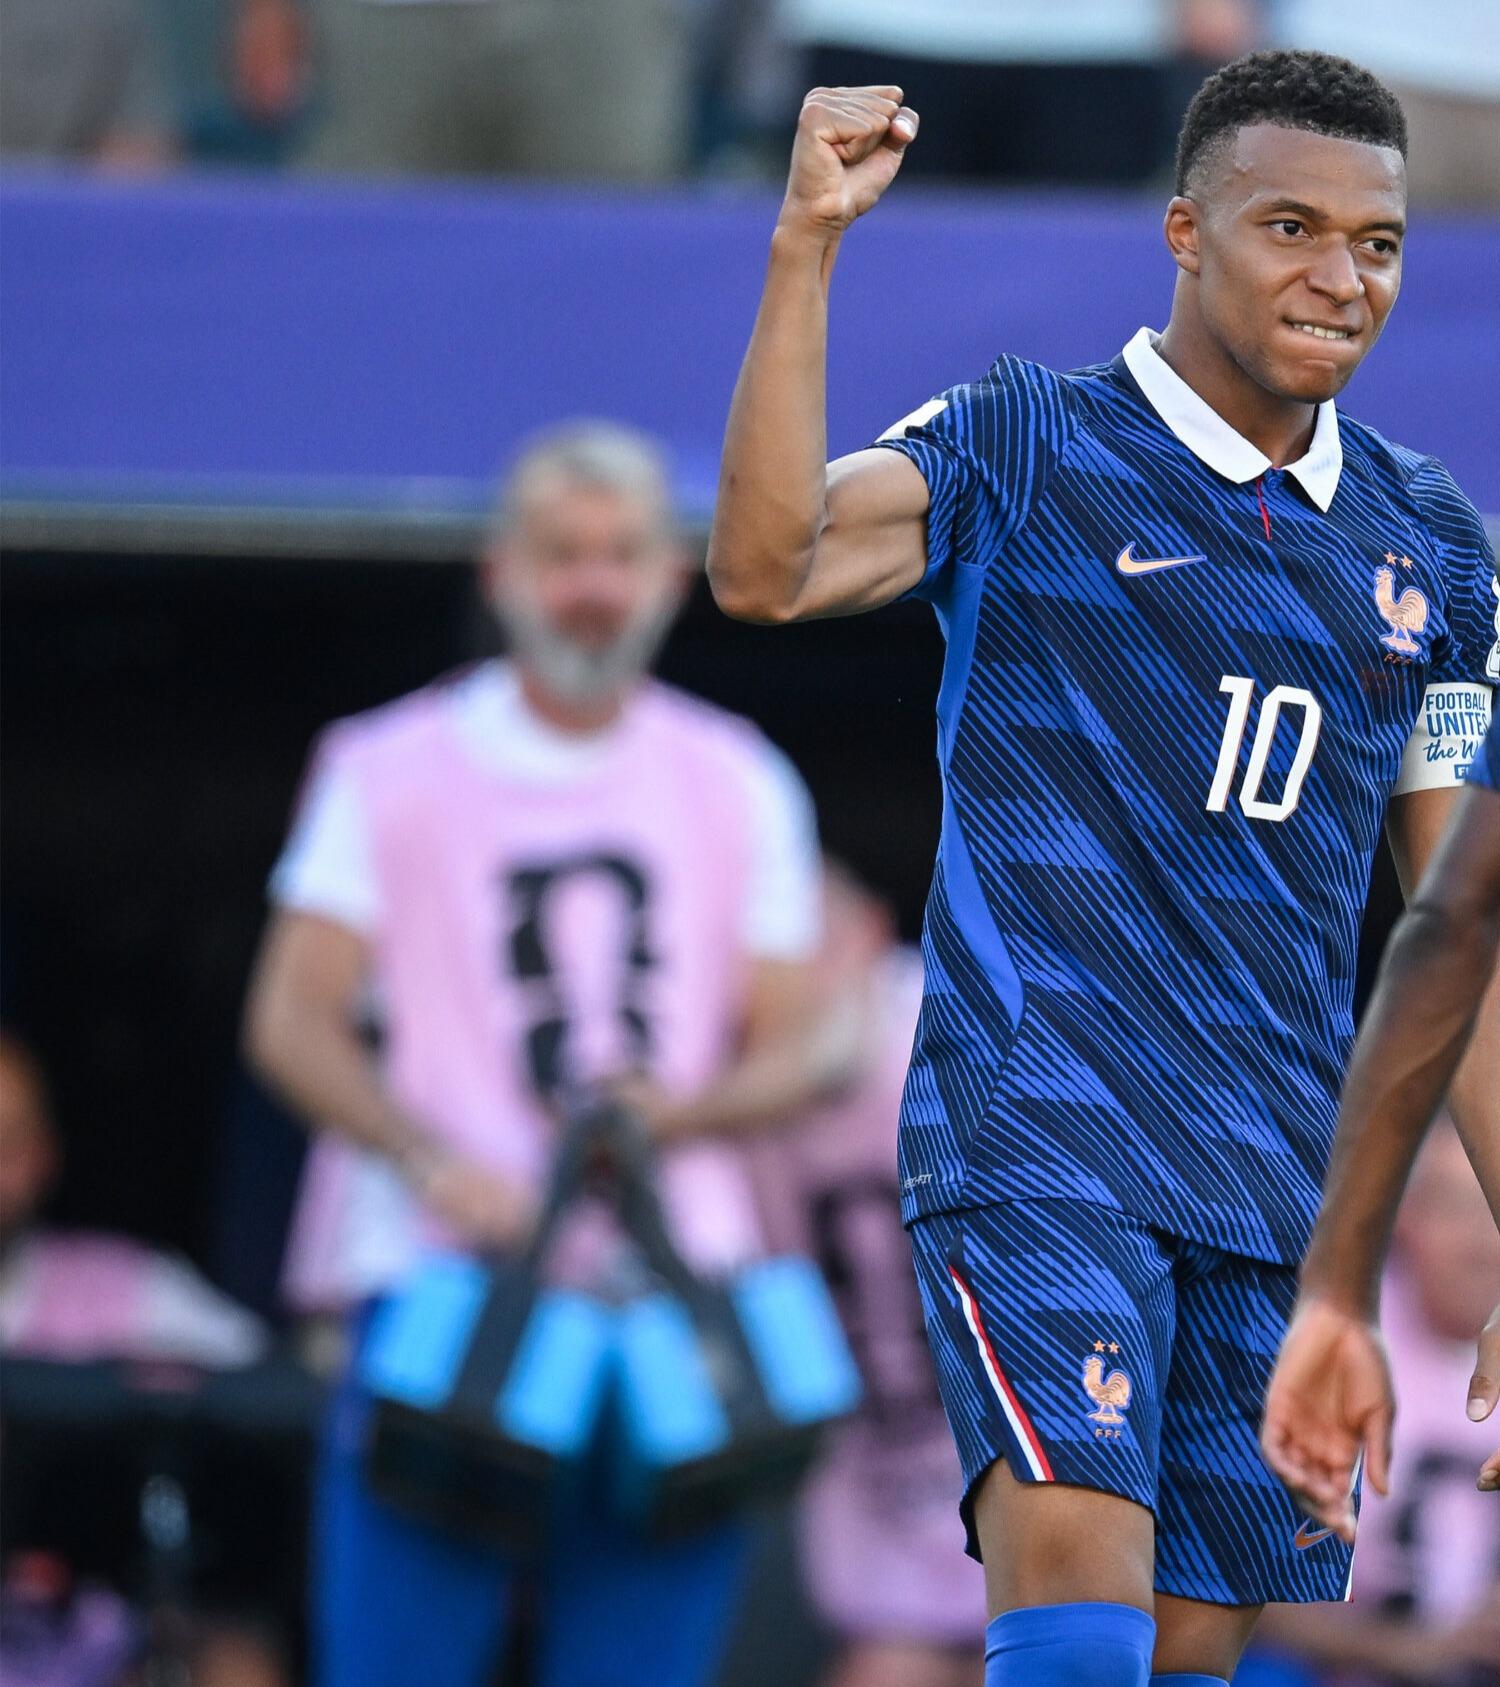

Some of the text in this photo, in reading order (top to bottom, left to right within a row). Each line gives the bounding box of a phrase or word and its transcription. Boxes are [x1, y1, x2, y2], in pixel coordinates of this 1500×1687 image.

[1425, 692, 1486, 711] FOOTBALL
[1426, 711, 1488, 738] UNITES
[1206, 674, 1322, 822] 10
[1422, 739, 1458, 762] the
[1095, 1428, 1121, 1439] FFF
